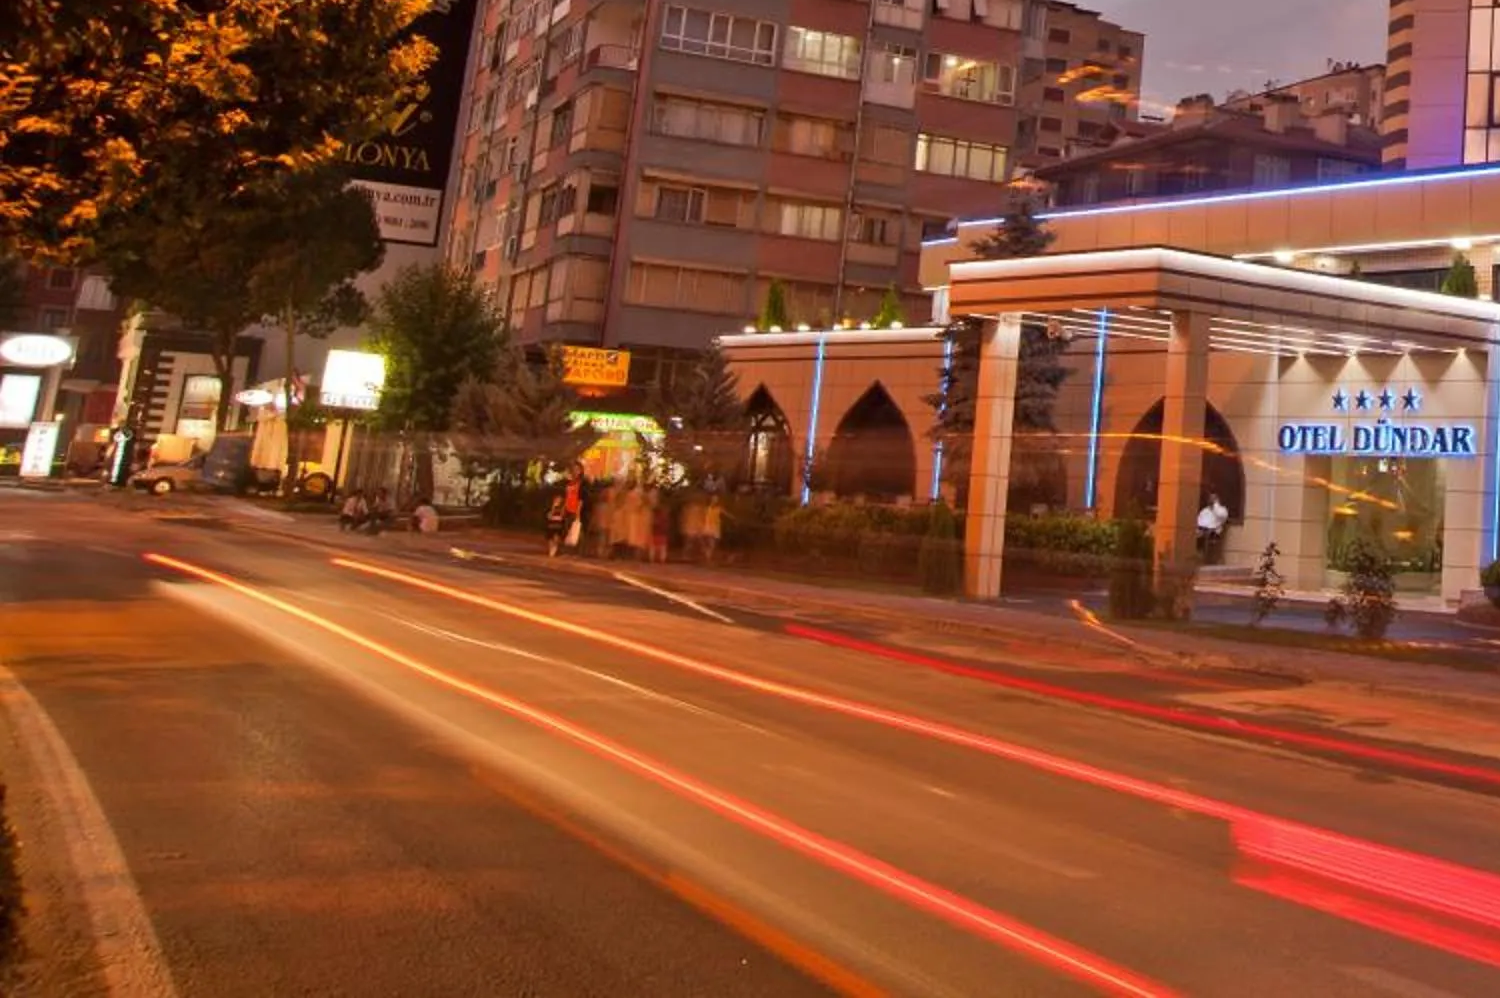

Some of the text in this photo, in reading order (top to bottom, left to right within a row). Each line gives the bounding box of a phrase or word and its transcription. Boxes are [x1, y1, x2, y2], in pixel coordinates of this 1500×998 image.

[344, 141, 430, 170] LONYA
[1278, 419, 1473, 454] OTEL DÜNDAR
